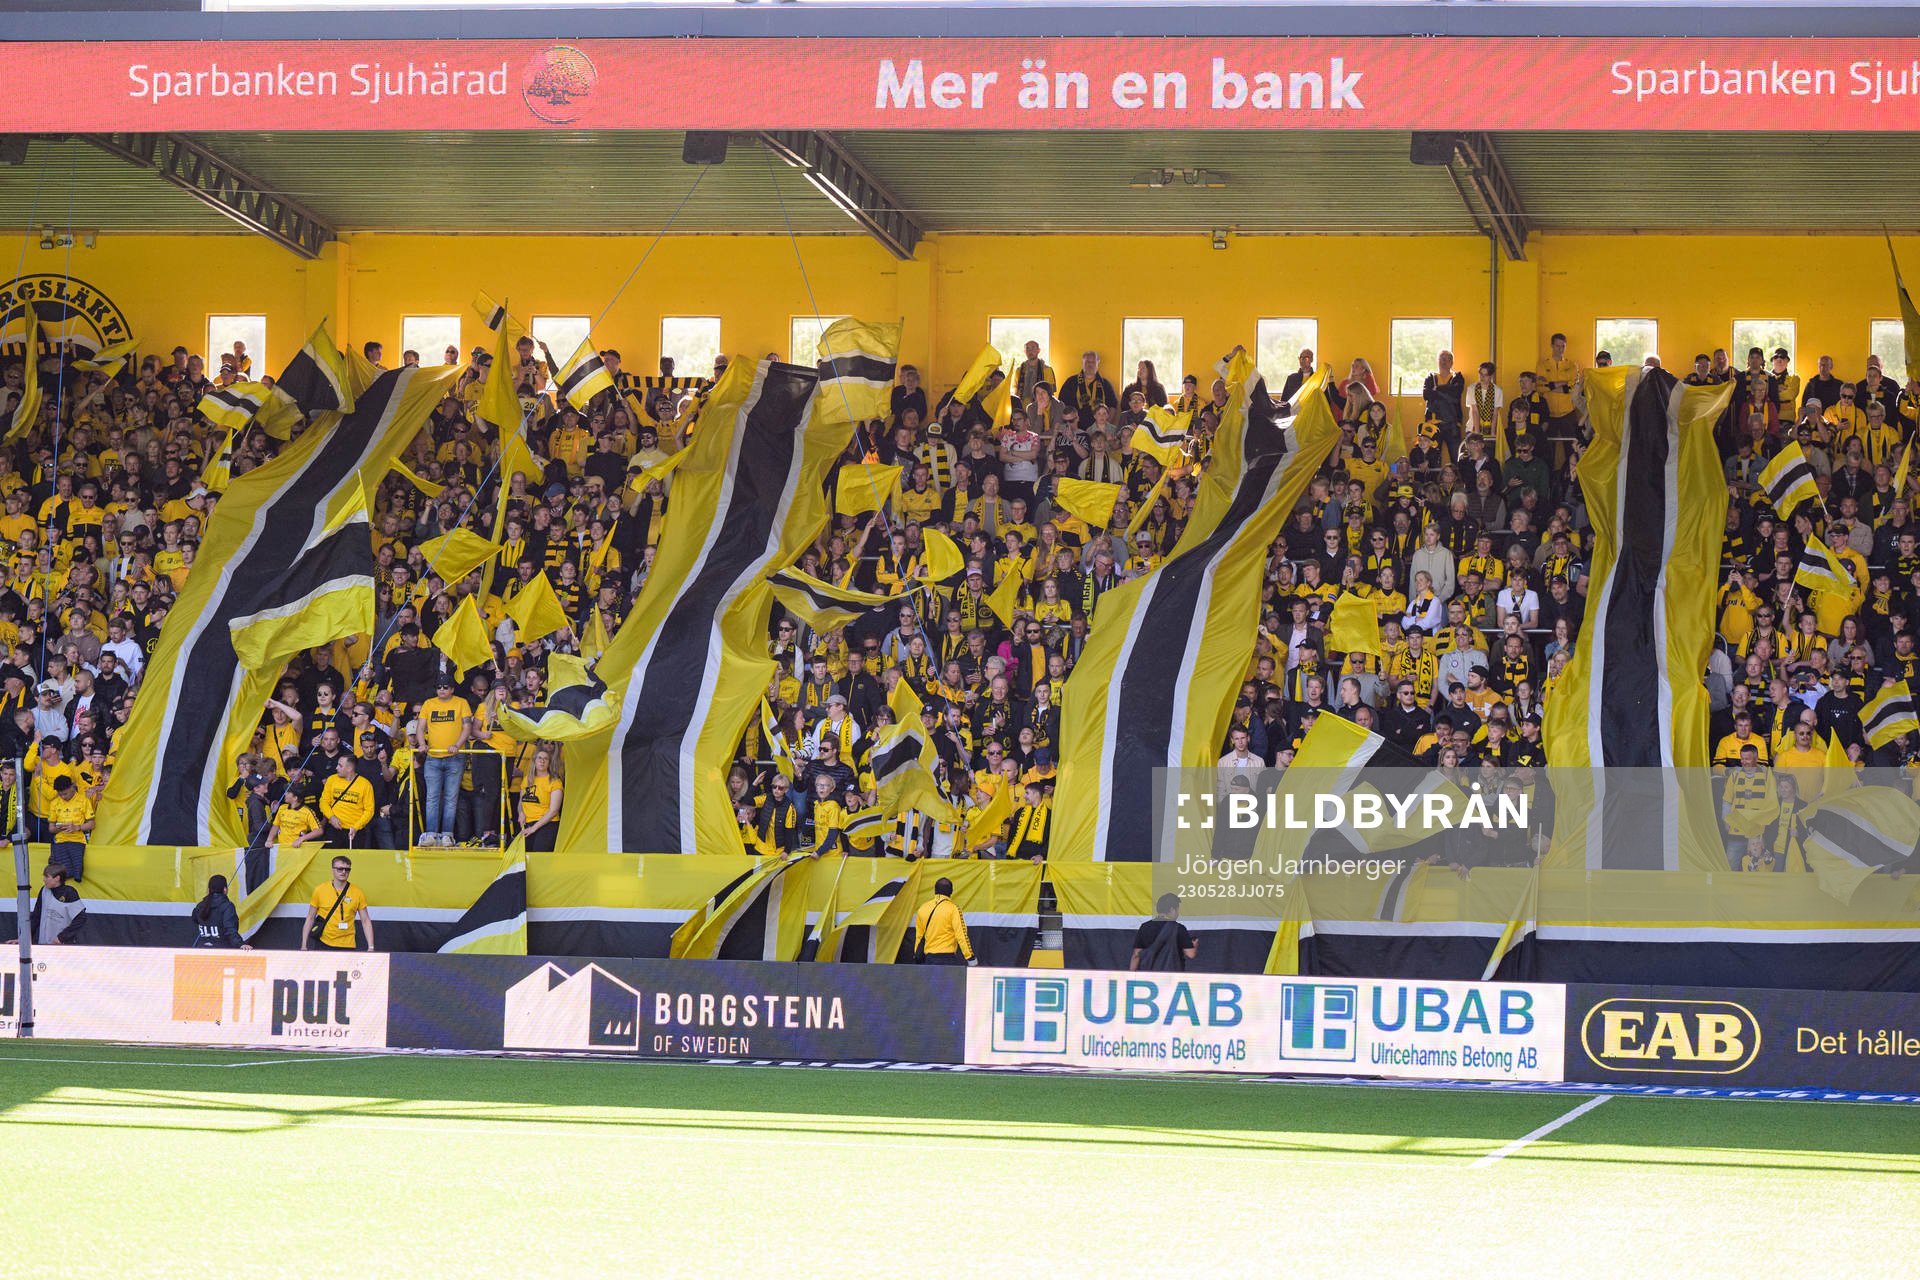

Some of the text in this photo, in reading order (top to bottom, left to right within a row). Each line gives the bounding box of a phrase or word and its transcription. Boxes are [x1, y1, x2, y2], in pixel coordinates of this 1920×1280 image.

[128, 62, 508, 104] Sparbanken Sjuhärad
[874, 57, 1364, 110] Mer än en bank
[1611, 60, 1836, 102] Sparbanken
[655, 992, 845, 1030] BORGSTENA
[1083, 978, 1244, 1028] UBAB
[1372, 986, 1535, 1036] UBAB
[288, 1024, 351, 1038] interiör
[654, 1035, 750, 1055] OF SWEDEN
[1082, 1034, 1246, 1065] Ulricehamns Betong AB
[1601, 1010, 1744, 1062] EAB
[1797, 1027, 1847, 1054] Det
[1371, 1041, 1537, 1073] Ulricehamns Betong AB
